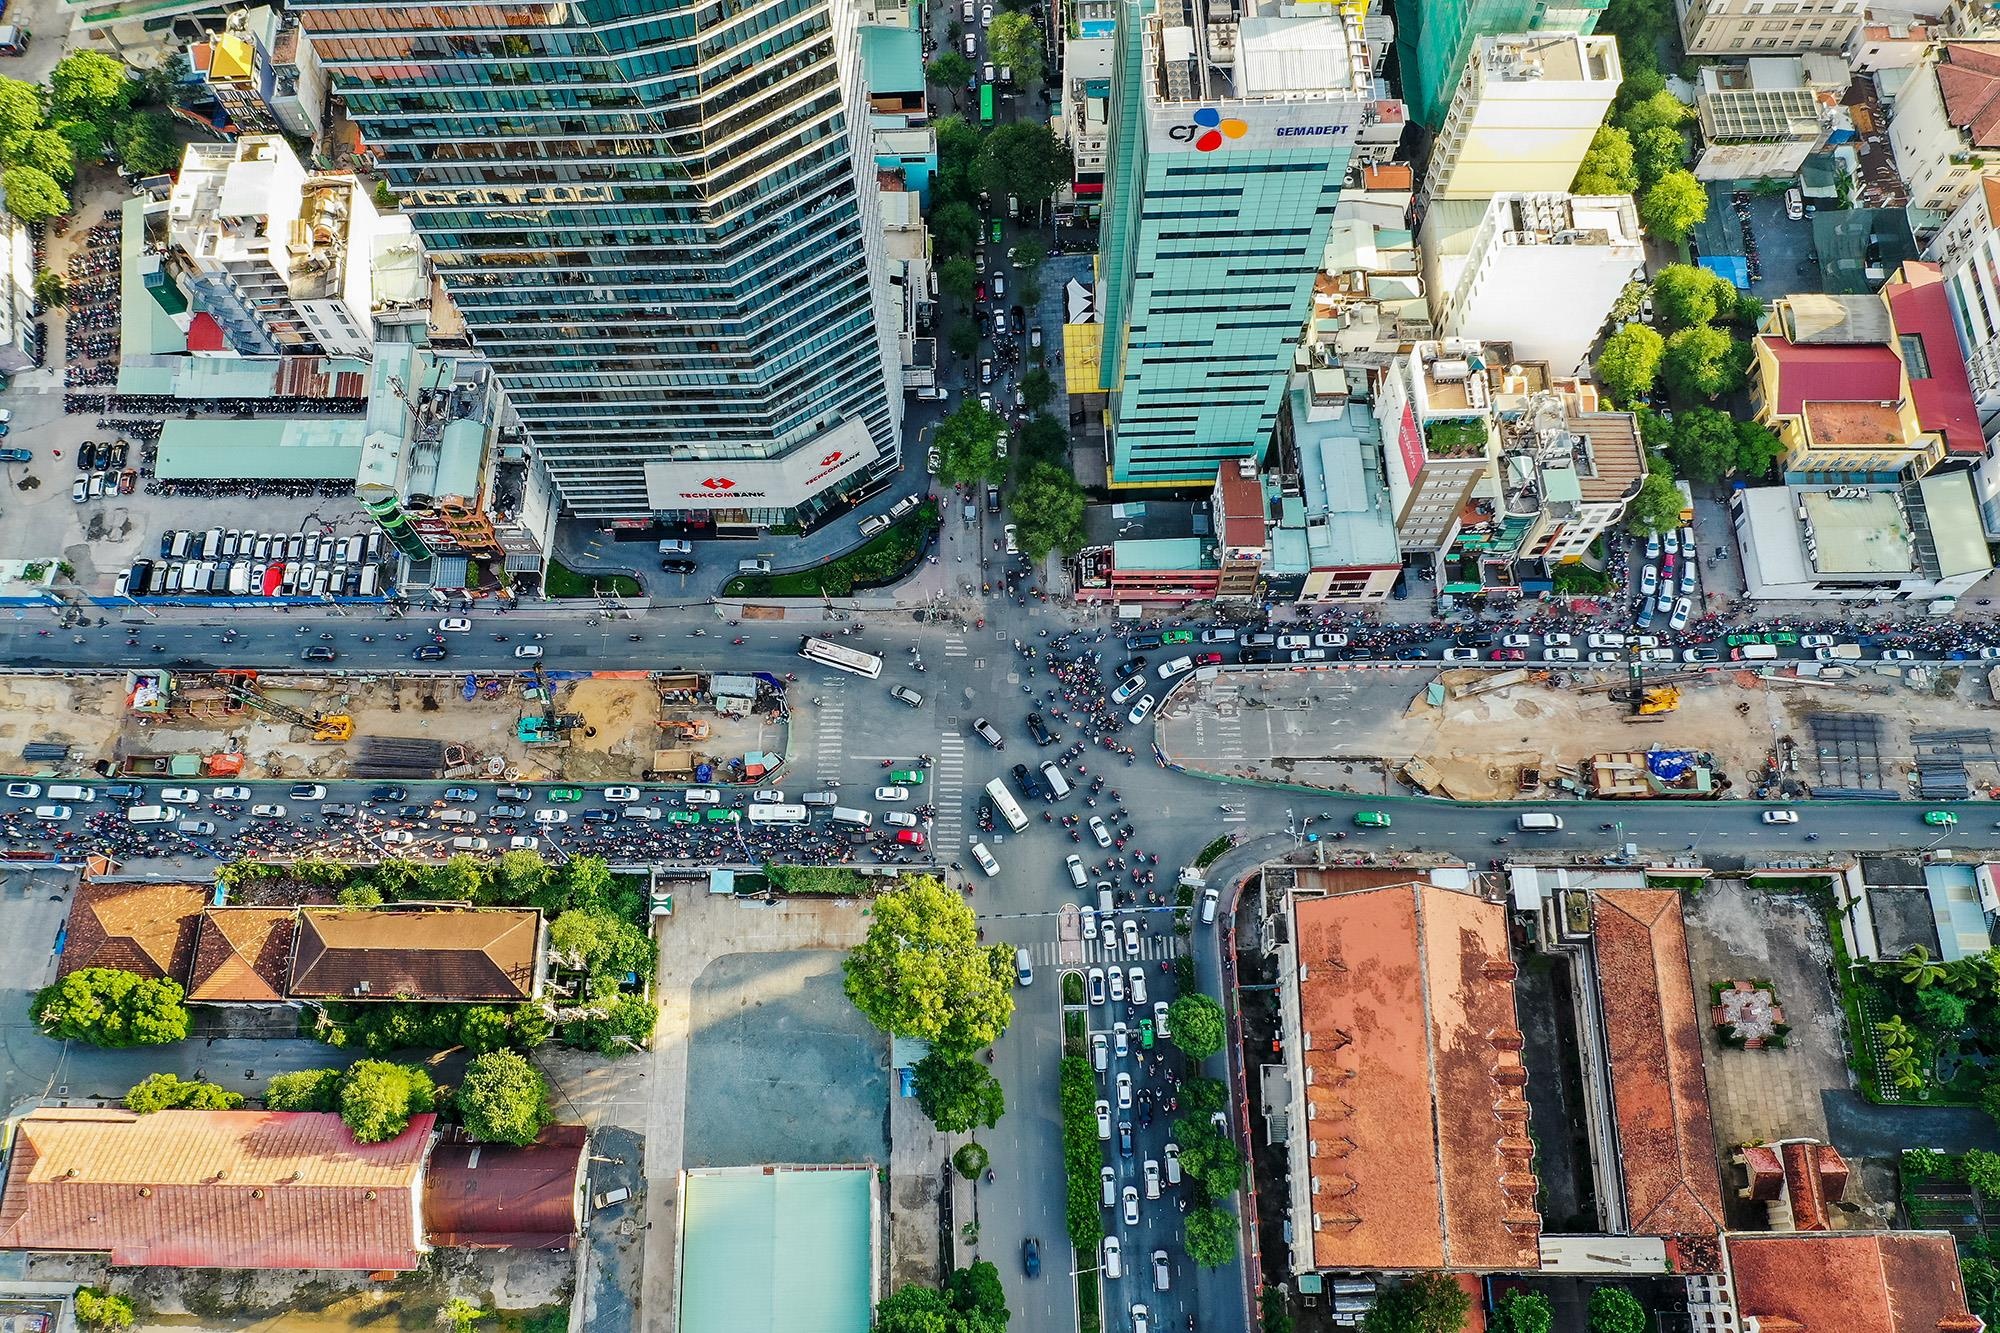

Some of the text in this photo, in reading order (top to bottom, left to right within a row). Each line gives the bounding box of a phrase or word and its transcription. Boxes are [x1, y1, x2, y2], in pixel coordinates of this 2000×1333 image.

[1169, 125, 1198, 143] CJ
[1276, 125, 1349, 137] GEMADEPT
[805, 451, 860, 486] TECHCOMBANK
[679, 491, 766, 499] TECHCOMBANK
